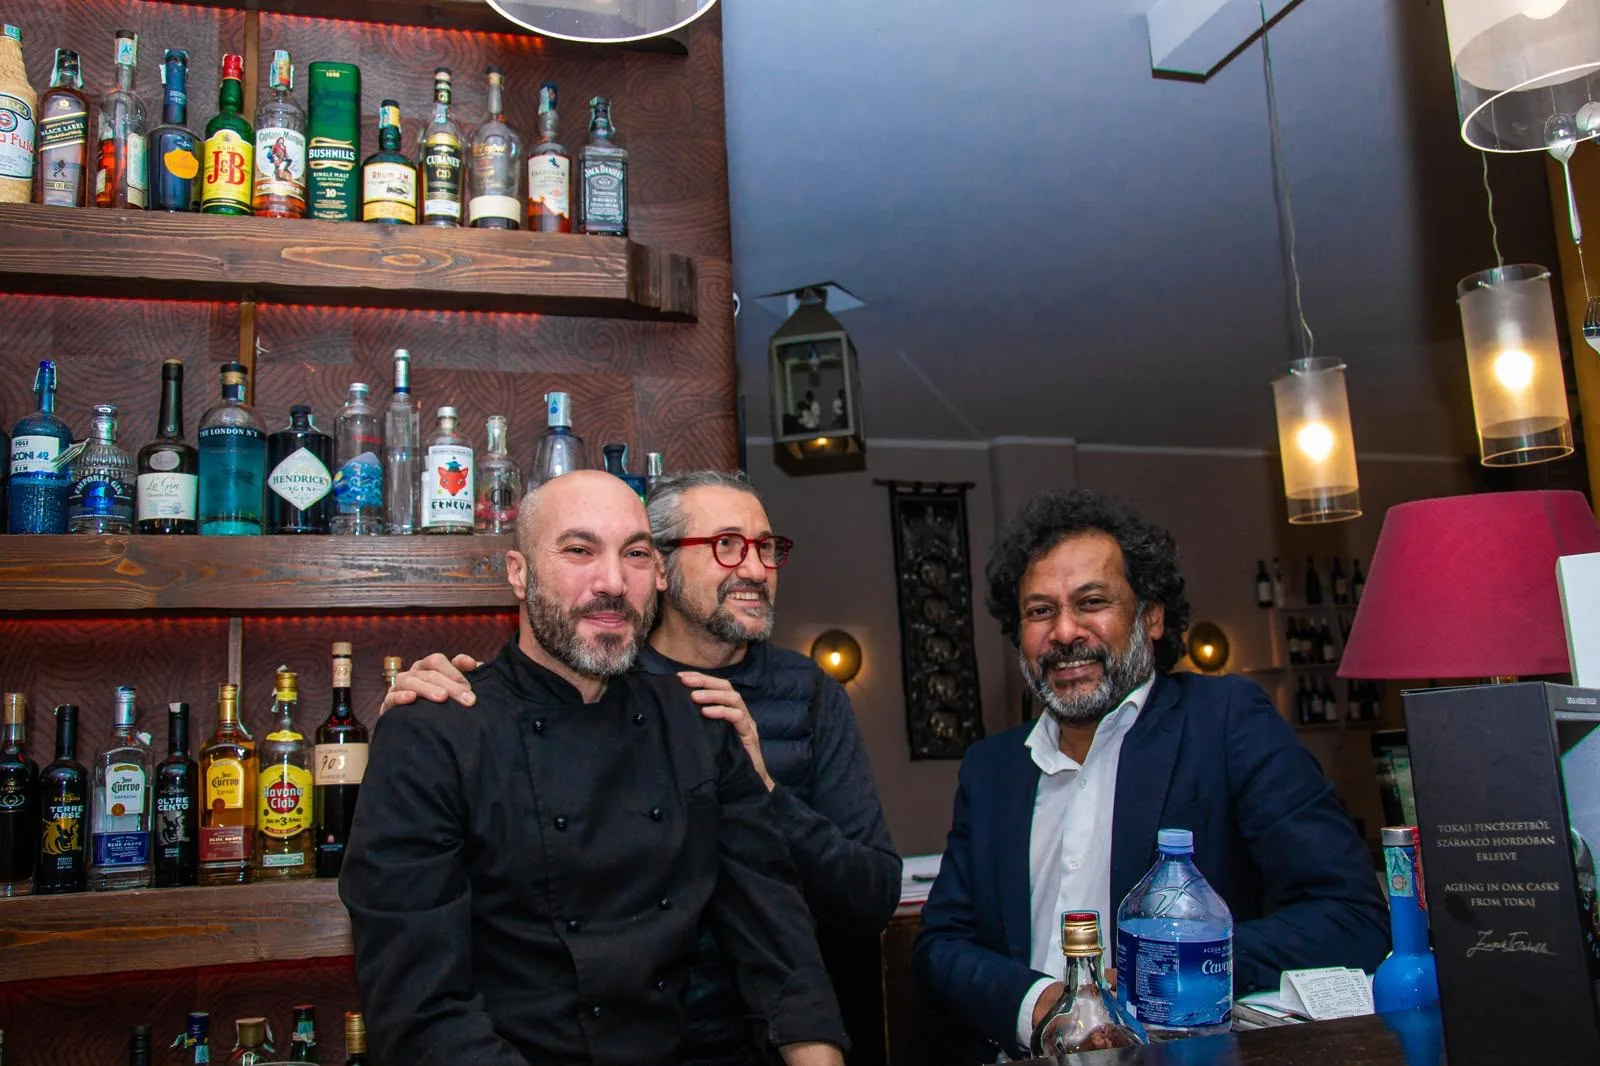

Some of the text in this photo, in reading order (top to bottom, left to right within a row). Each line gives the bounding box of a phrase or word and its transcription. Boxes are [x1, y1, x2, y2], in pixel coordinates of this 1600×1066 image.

[41, 126, 63, 136] BLACK
[63, 122, 85, 131] LABEL
[309, 149, 356, 161] BUSHMILLS
[426, 154, 461, 169] CUBANEY
[207, 151, 246, 185] J&B
[325, 188, 337, 198] 10
[210, 427, 244, 436] LONDON
[36, 451, 49, 461] 42
[74, 475, 123, 495] EMPORIA GIN
[272, 474, 329, 487] HENDRICK'S
[111, 780, 140, 794] Cuervo
[211, 776, 240, 789] Cuervo
[263, 786, 304, 798] Havana
[157, 796, 189, 805] OLTRE
[270, 797, 295, 809] Club
[50, 805, 84, 813] TERRE
[1437, 824, 1472, 834] TOKAJI
[1444, 881, 1560, 892] AGEING IN OAK CASKS
[1471, 897, 1536, 908] FROM TOKAJ
